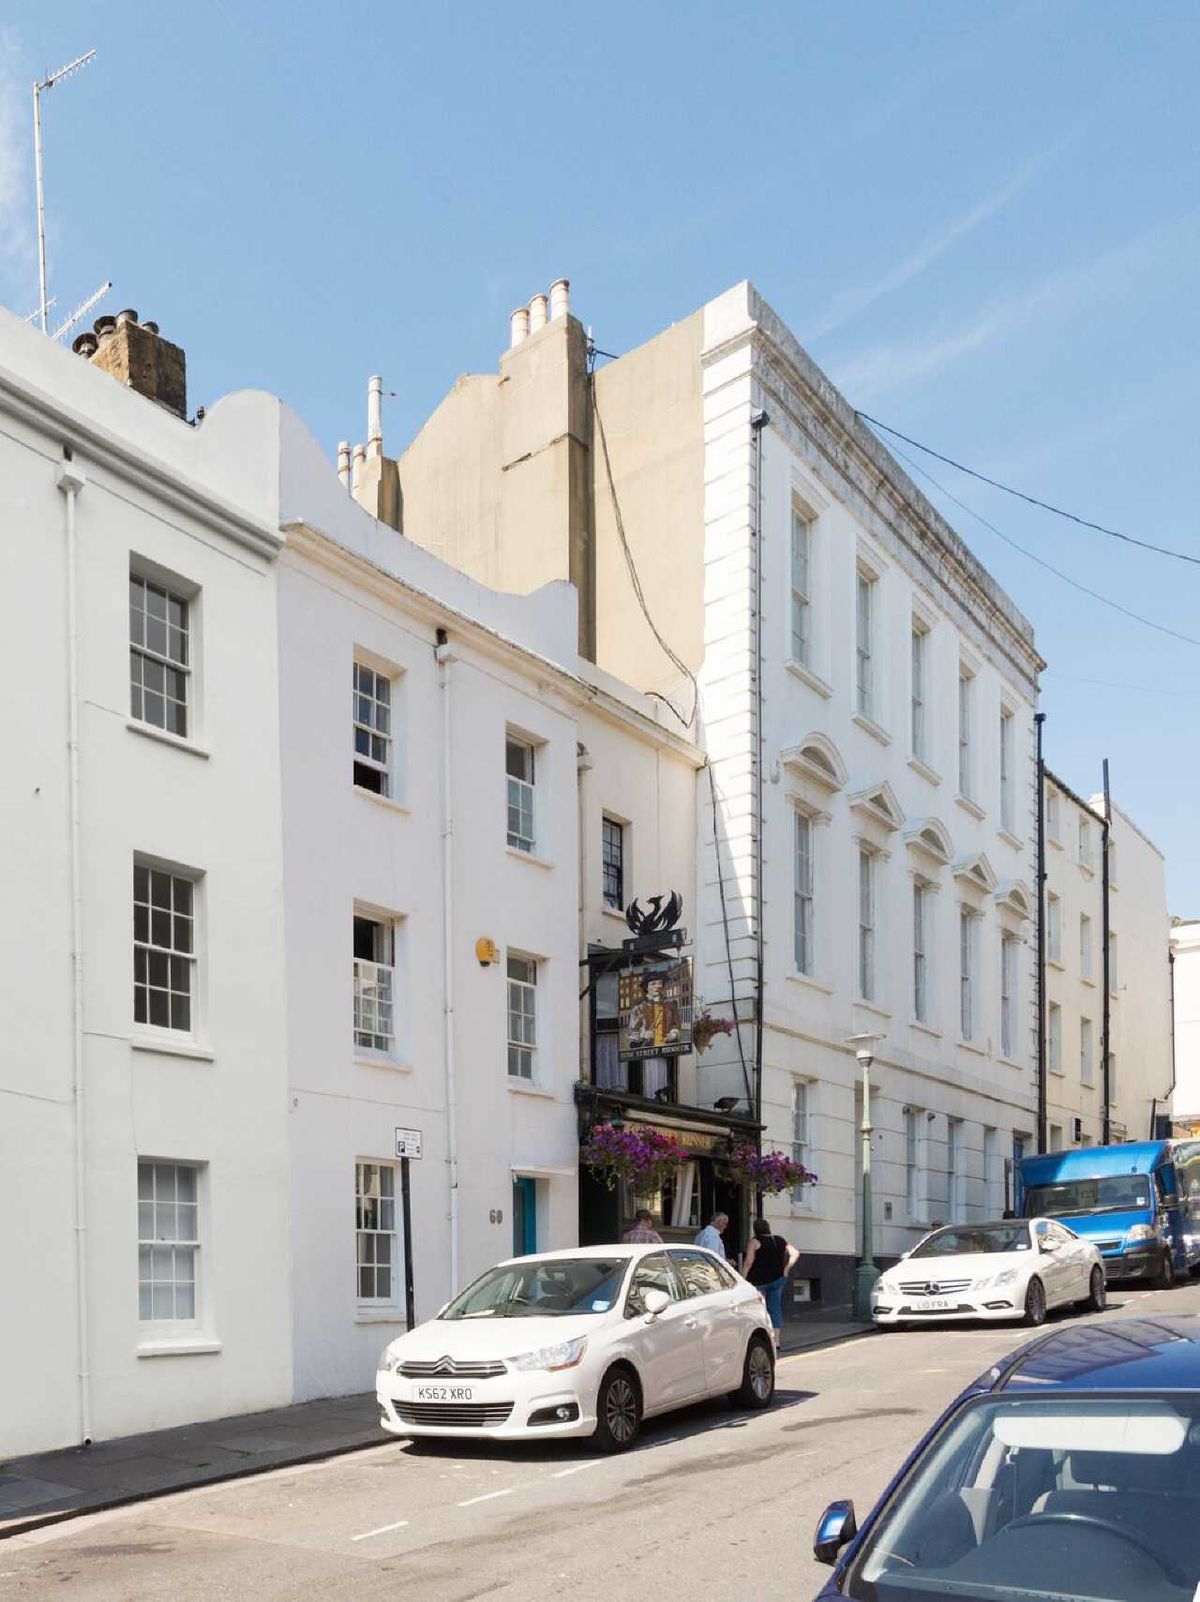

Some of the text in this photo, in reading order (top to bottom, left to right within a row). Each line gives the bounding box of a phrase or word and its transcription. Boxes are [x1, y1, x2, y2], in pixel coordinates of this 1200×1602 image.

[489, 1208, 503, 1225] 60
[418, 1387, 473, 1400] KS62 XRO
